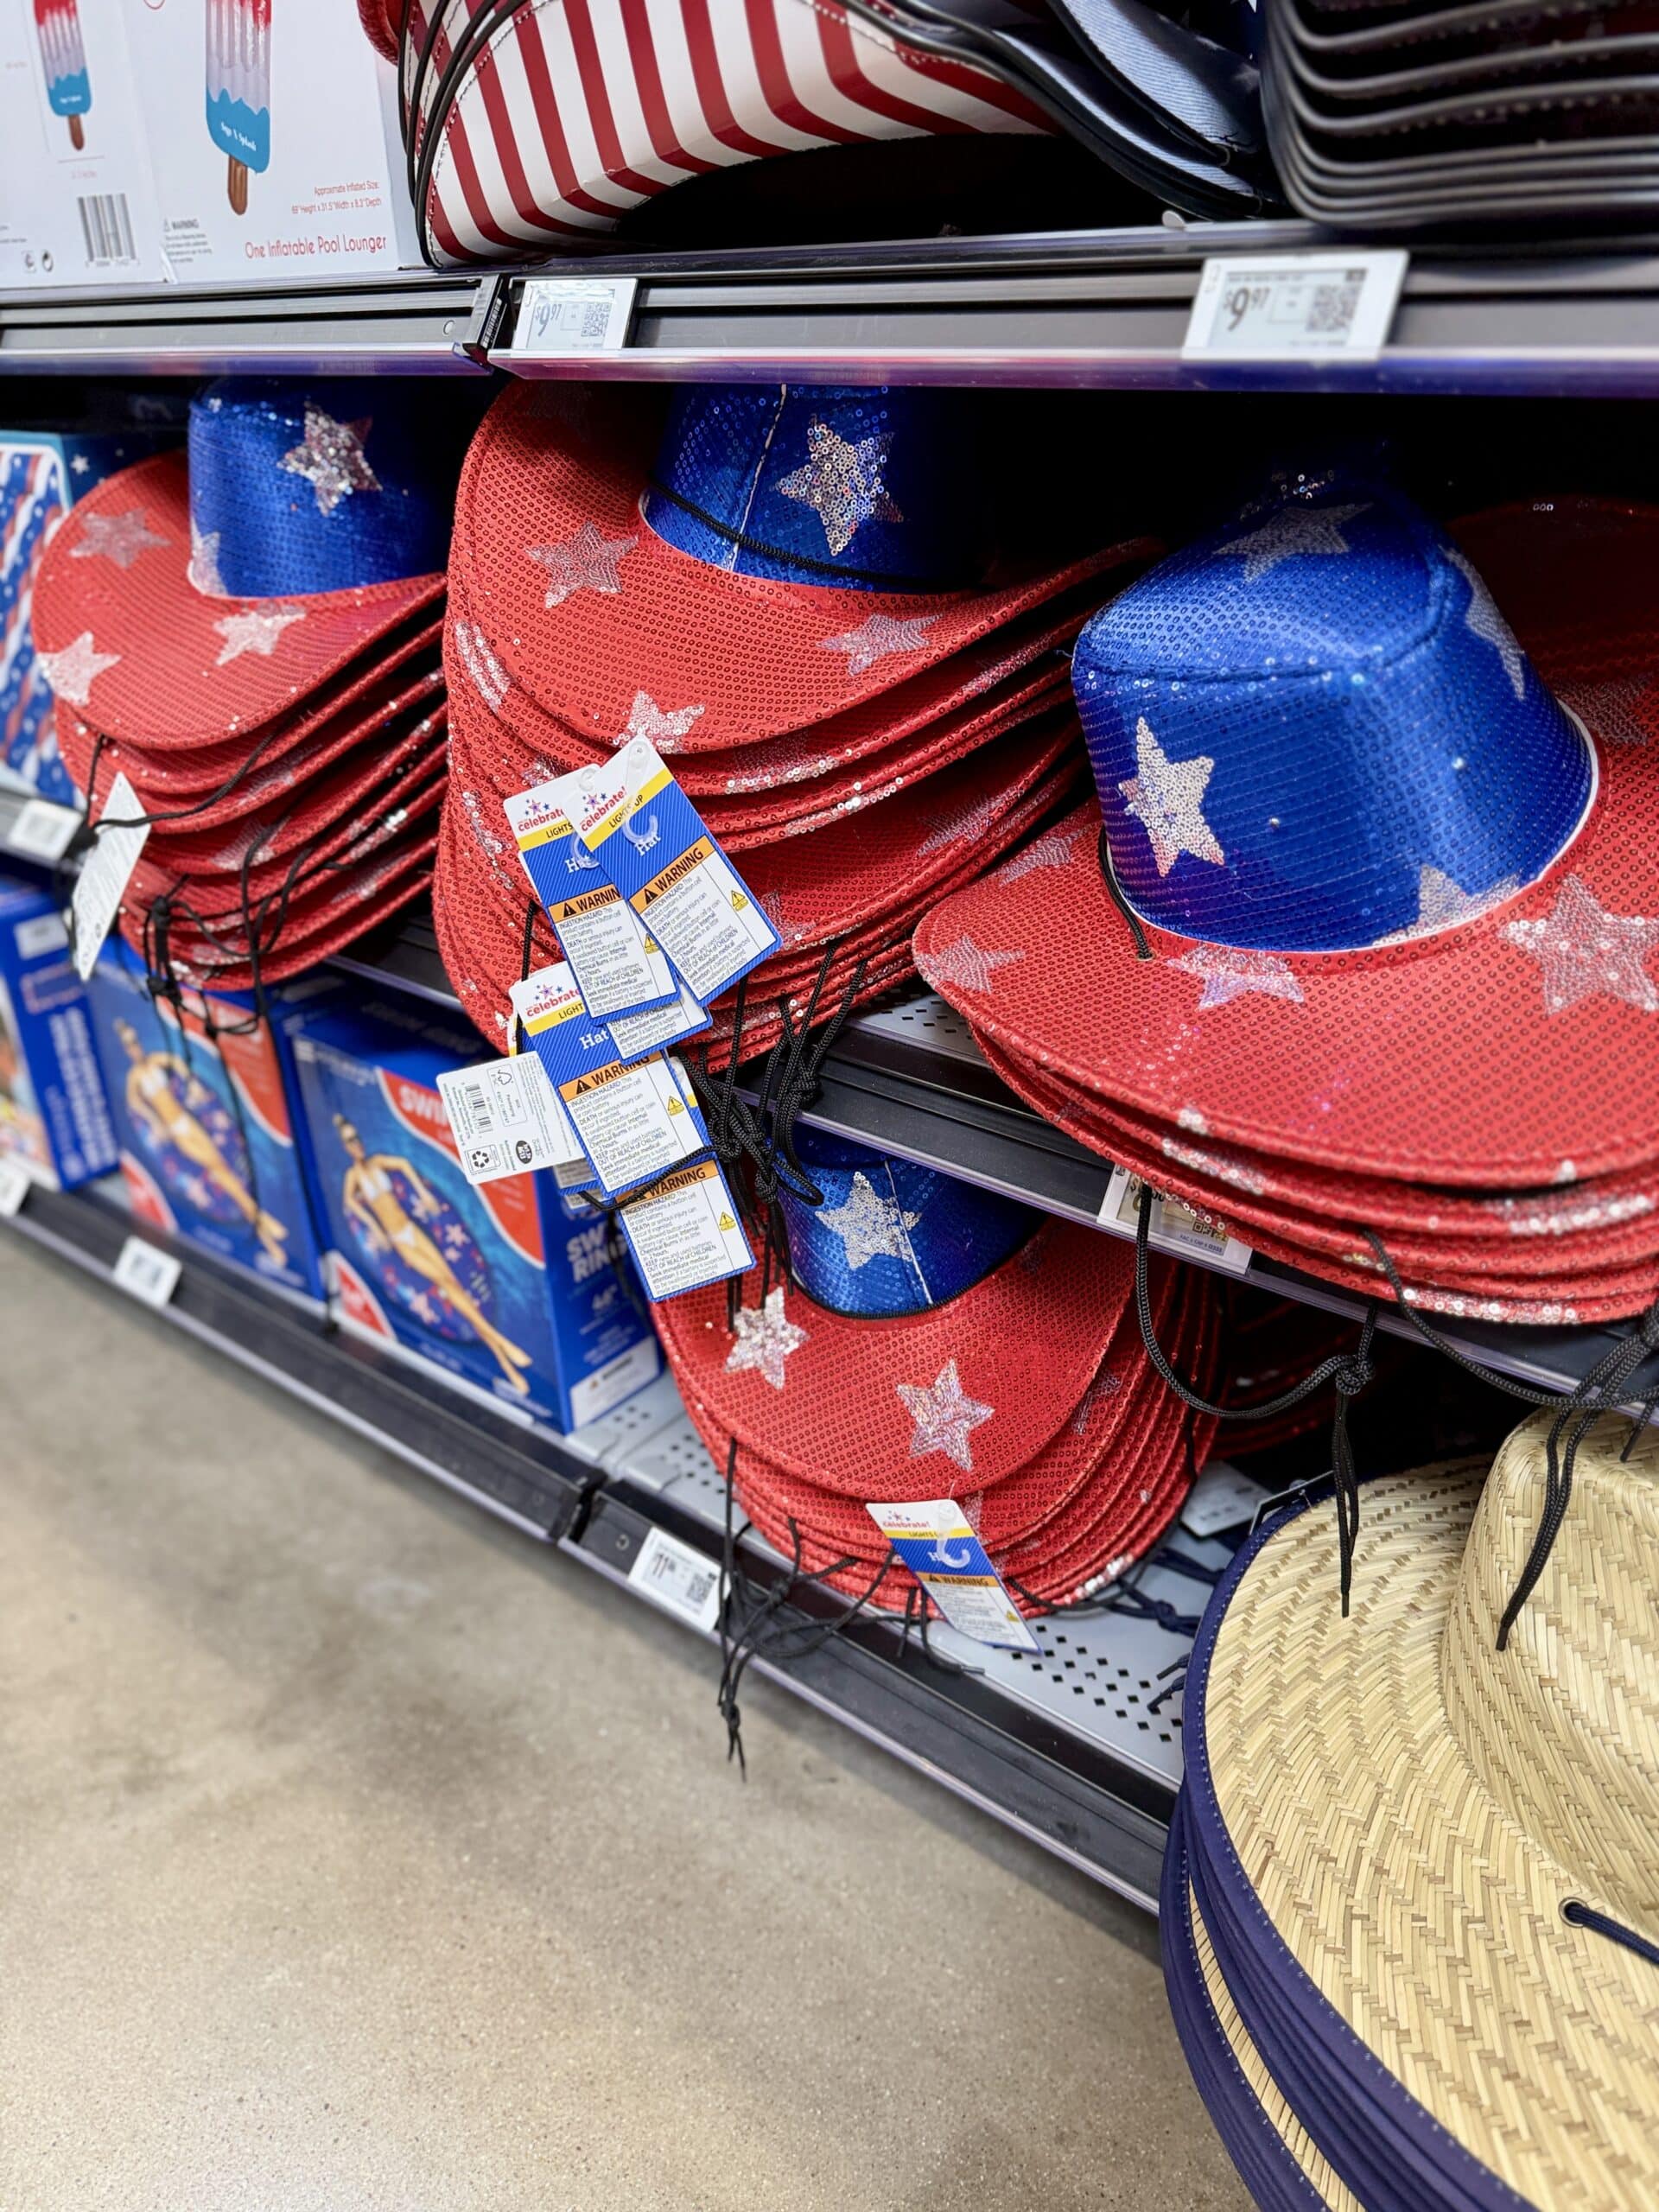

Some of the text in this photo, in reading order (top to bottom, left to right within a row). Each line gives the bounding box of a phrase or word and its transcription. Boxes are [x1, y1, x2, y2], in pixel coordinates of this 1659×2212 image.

[315, 185, 346, 197] Approximate
[346, 183, 365, 192] Inflated
[245, 233, 386, 258] One Inflatable Pool Lounger
[582, 785, 627, 832] celebrate!
[545, 822, 573, 839] LIGHTS
[654, 847, 704, 892] WARNING
[575, 887, 621, 912] WARNIN
[558, 1002, 583, 1020] LIGHT
[578, 1028, 609, 1050] Hat
[570, 1090, 598, 1106] INGESTION
[579, 1113, 597, 1124] DEATH
[627, 1111, 647, 1123] Internal
[589, 1134, 612, 1147] Chemical
[613, 1150, 639, 1166] immediate
[640, 1141, 660, 1154] medical
[617, 1145, 635, 1156] REACH
[604, 1163, 626, 1177] attention
[648, 1166, 706, 1197] WARNING
[942, 1576, 989, 1586] WARNING
